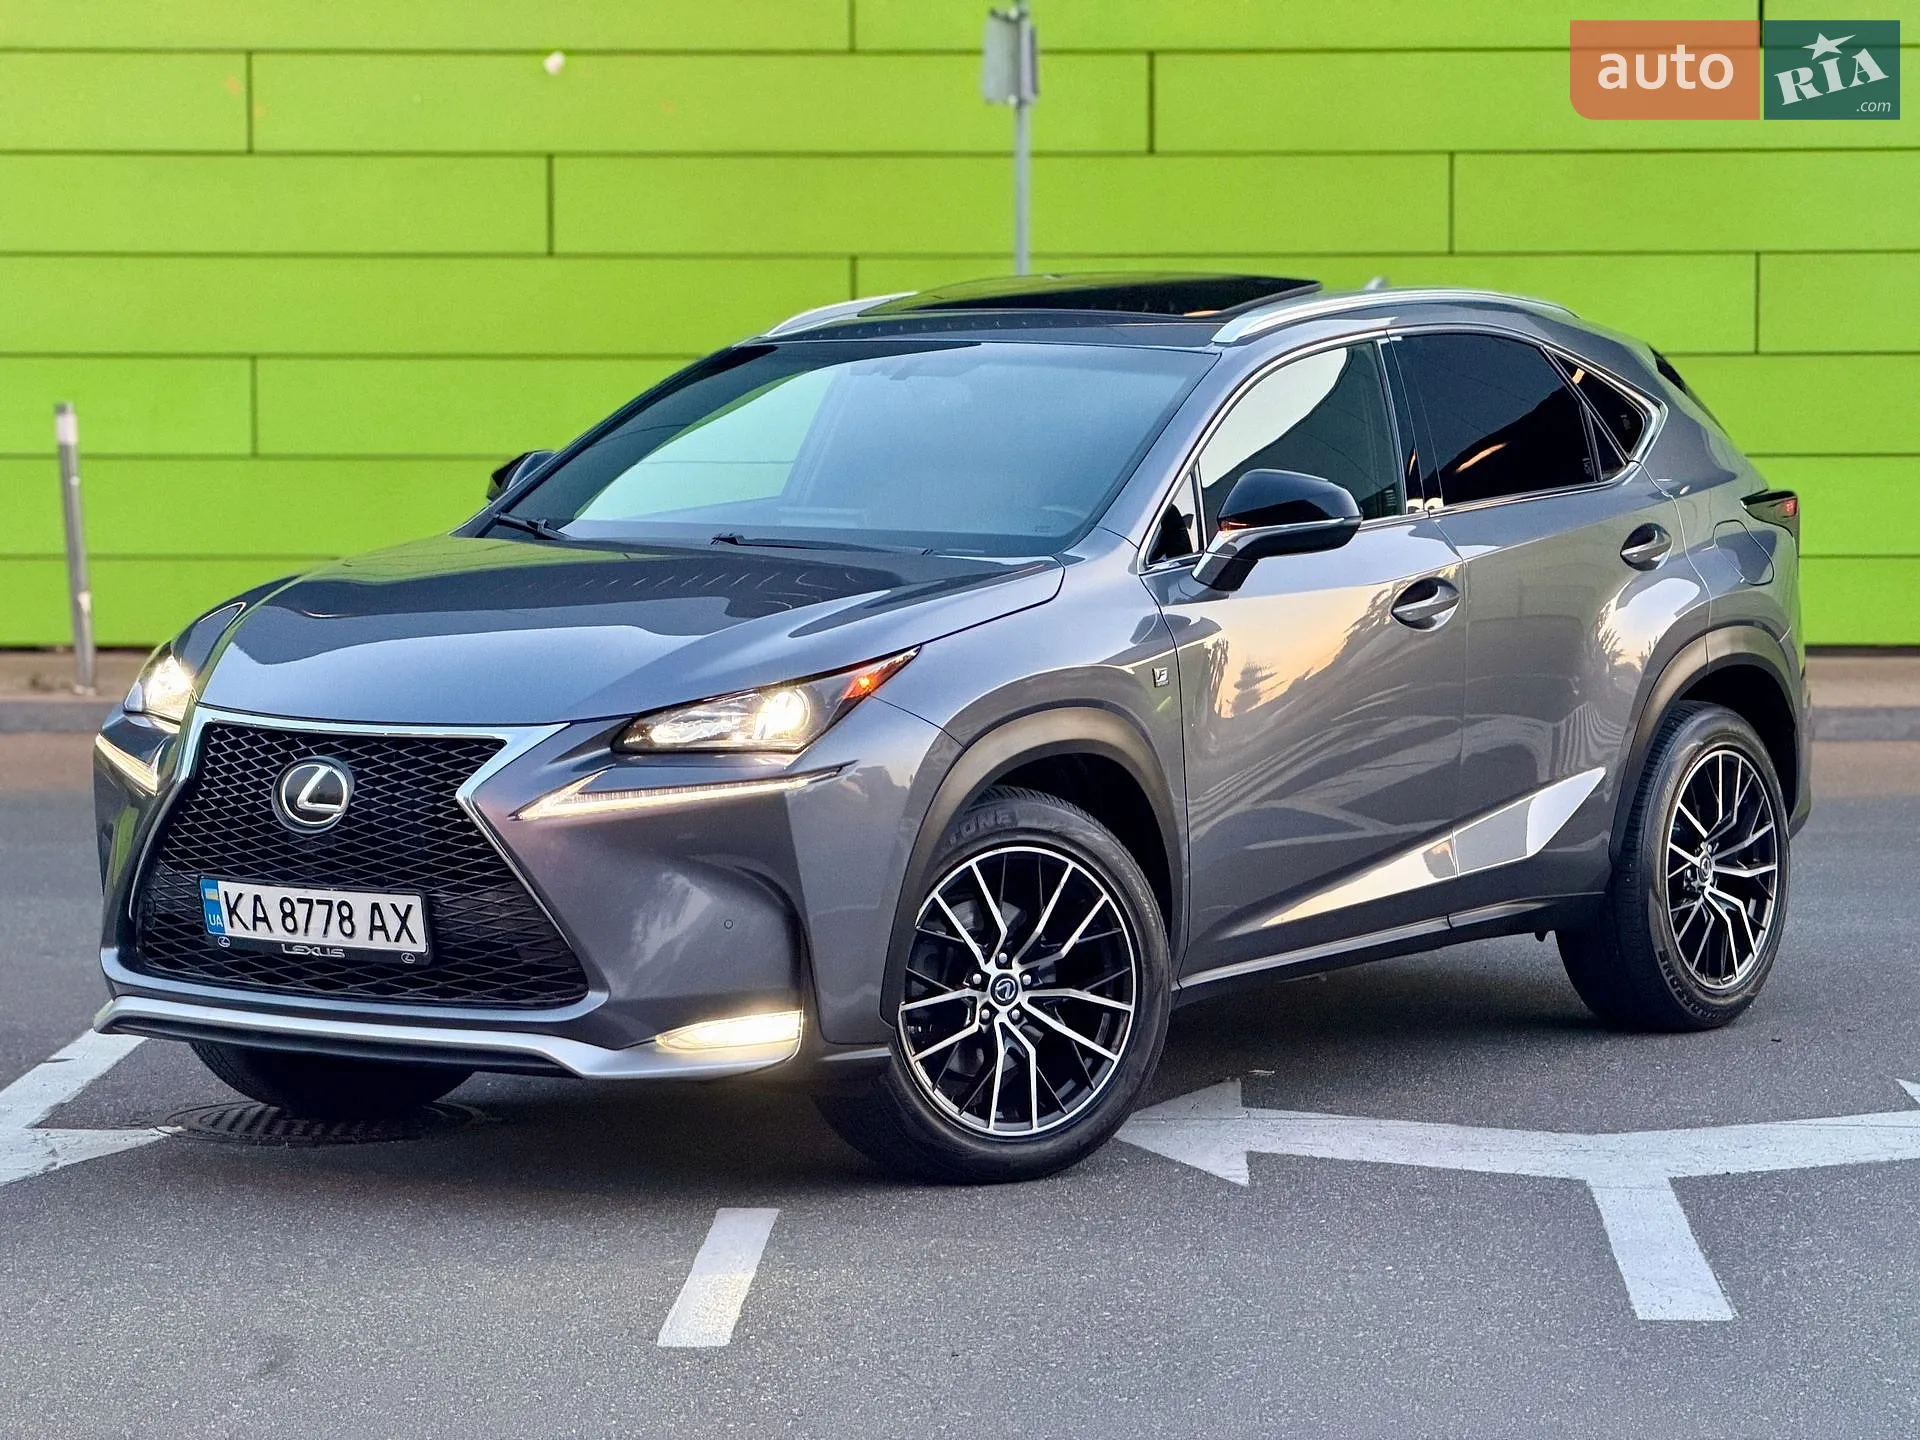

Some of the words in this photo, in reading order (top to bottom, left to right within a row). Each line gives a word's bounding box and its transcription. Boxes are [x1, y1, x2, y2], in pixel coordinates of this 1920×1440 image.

[208, 914, 223, 928] UA
[224, 890, 273, 933] KA
[279, 896, 356, 939] 8778
[368, 902, 418, 944] AX
[281, 943, 345, 958] LEXUS
